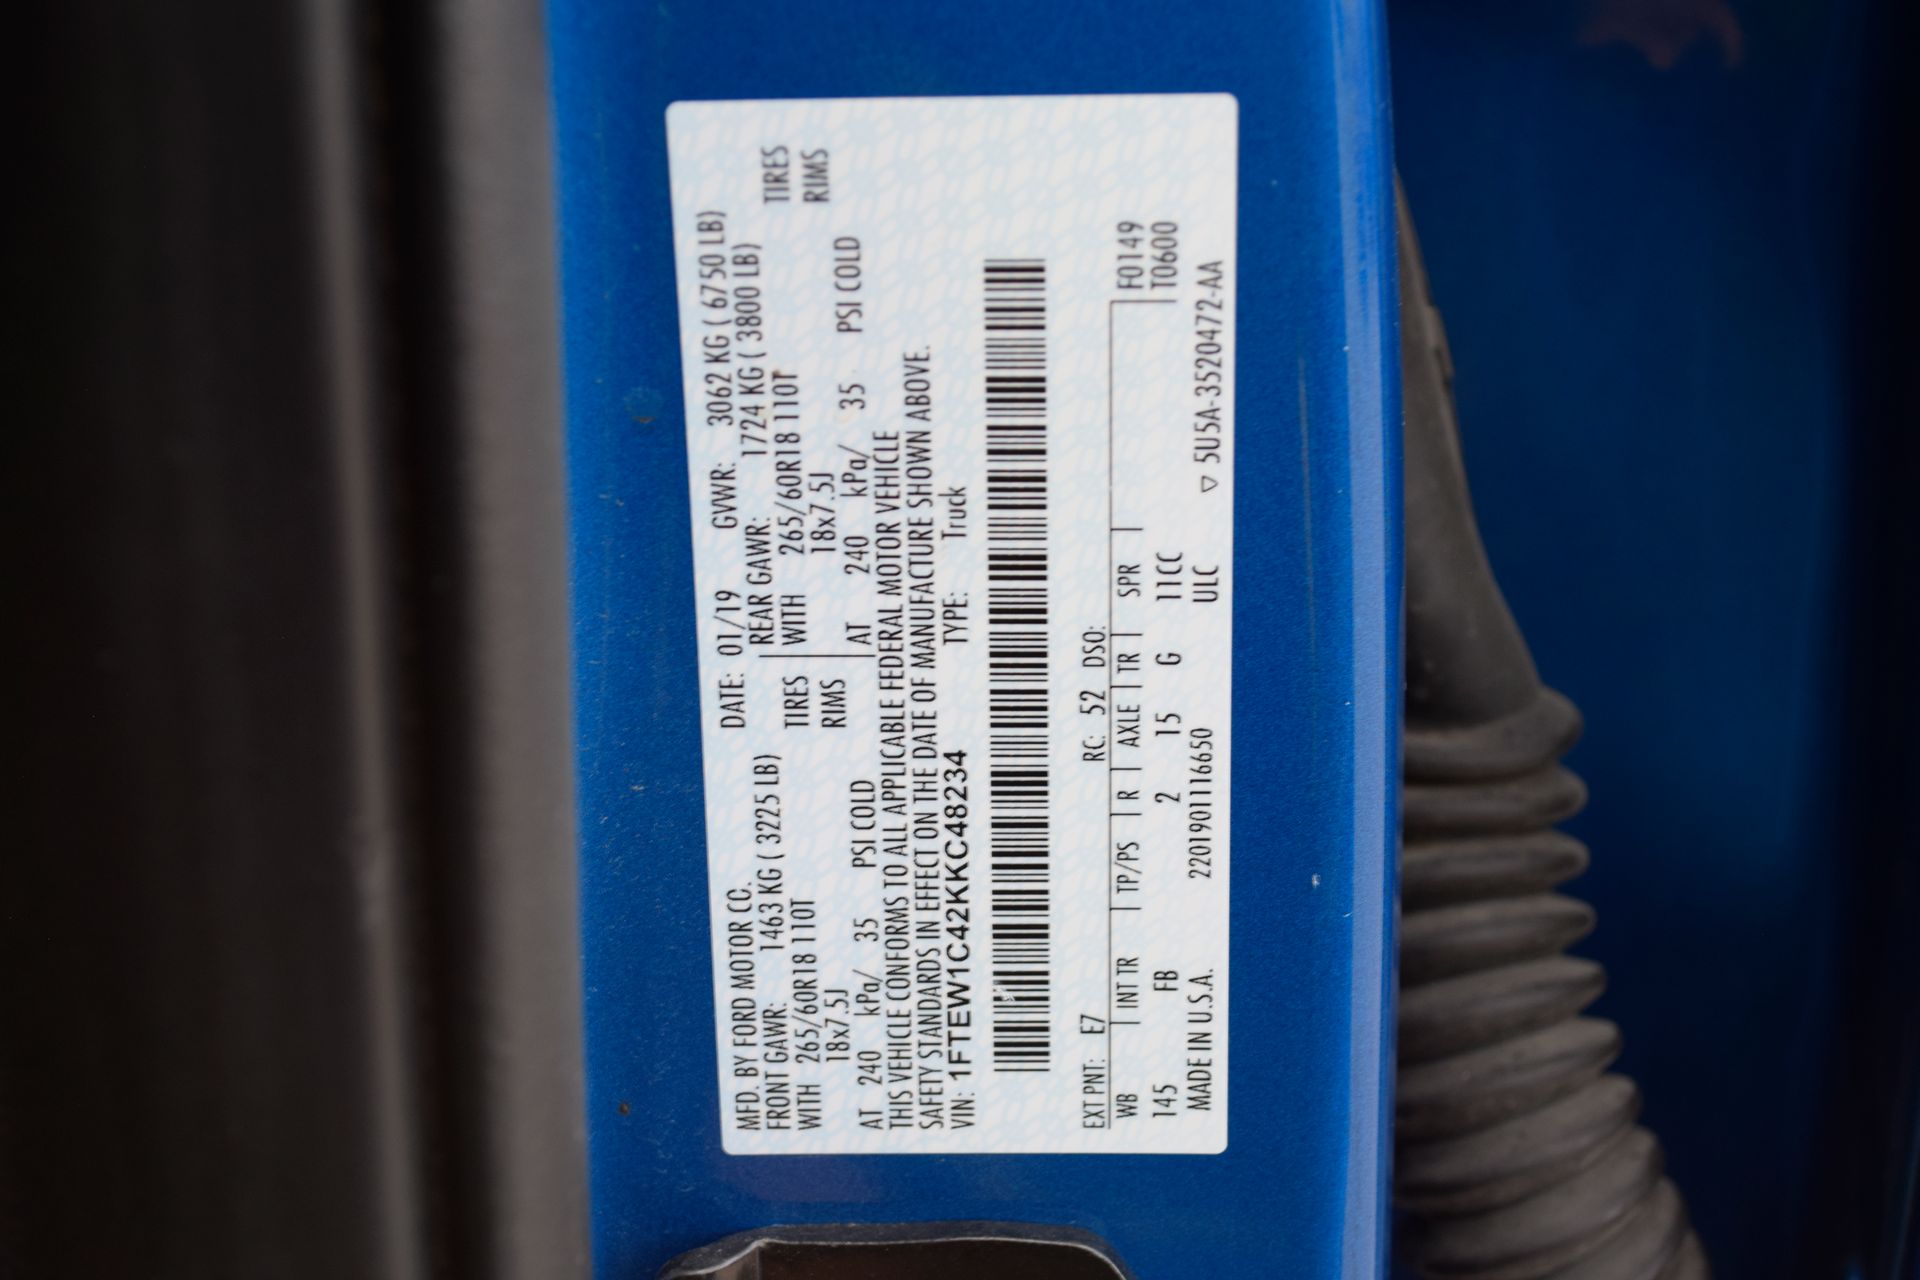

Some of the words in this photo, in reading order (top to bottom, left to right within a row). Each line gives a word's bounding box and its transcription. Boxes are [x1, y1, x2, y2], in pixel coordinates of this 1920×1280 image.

[762, 146, 789, 202] TIRES
[801, 149, 828, 202] RIMS
[697, 211, 726, 244] LB)
[732, 244, 761, 277] LB)
[834, 237, 862, 292] COLD
[1117, 221, 1144, 289] F0149
[1151, 222, 1178, 289] T0600
[699, 254, 728, 309] 6750
[734, 287, 762, 341] 3800
[835, 302, 863, 333] PSI
[703, 335, 730, 363] KG
[1194, 261, 1222, 463] 5U5A-3520472-AA
[704, 373, 733, 426] 3062
[737, 367, 765, 395] KG
[772, 370, 799, 421] 110T
[838, 384, 865, 410] 35
[903, 345, 931, 422] ABOVE.
[739, 405, 767, 457] 1724
[774, 432, 807, 555] 265/60R18
[838, 444, 871, 497] kPa/
[872, 432, 901, 514] VEHICLE
[905, 431, 933, 509] SHOWN
[710, 463, 738, 529] GVWR:
[808, 473, 836, 554] 18x7.5J
[937, 487, 967, 540] Truck
[744, 518, 773, 585] GAWR:
[843, 536, 870, 575] 240
[875, 522, 902, 596] MOTOR
[907, 518, 936, 669] MANUFACTURE
[1117, 564, 1141, 597] SPR
[1155, 552, 1183, 601] 11CC
[1192, 566, 1219, 603] ULC
[713, 590, 746, 656] 01/19
[747, 594, 775, 645] REAR
[780, 595, 807, 646] WITH
[845, 622, 872, 645] AT
[942, 592, 969, 646] TYPE:
[877, 604, 905, 690] FEDERAL
[1082, 626, 1106, 667] DSO:
[1117, 653, 1140, 674] TR
[1155, 652, 1182, 666] G
[718, 673, 746, 728] DATE:
[782, 675, 810, 729] TIRES
[819, 679, 847, 728] RIMS
[910, 678, 937, 703] OF
[1079, 690, 1106, 715] 52
[911, 711, 938, 759] DATE
[1082, 736, 1106, 761] RC:
[1117, 704, 1140, 748] AXLE
[1155, 713, 1181, 737] 15
[753, 754, 782, 785] LB)
[879, 699, 907, 816] APPLICABLE
[850, 780, 876, 830] COLD
[912, 768, 938, 804] THE
[1116, 790, 1140, 800] R
[1154, 792, 1181, 803] 2
[1188, 728, 1213, 879] 2201901116650
[754, 794, 781, 844] 3225
[882, 823, 908, 857] ALL
[913, 812, 939, 839] ON
[850, 840, 877, 868] PSI
[882, 864, 909, 889] TO
[1114, 842, 1142, 894] TP/PS
[726, 882, 752, 913] CO.
[756, 868, 783, 894] KG
[913, 848, 940, 911] EFFECT
[758, 903, 785, 951] 1463
[790, 898, 816, 944] 110T
[853, 918, 879, 942] 35
[915, 921, 941, 939] IN
[942, 749, 972, 1081] 1FTEW1C42KKC48234
[728, 921, 755, 990] MOTOR
[883, 896, 911, 1001] CONFORMS
[1116, 957, 1139, 976] TR
[852, 969, 883, 1016] kPa/
[915, 948, 943, 1059] STANDARDS
[1116, 982, 1139, 1008] INT
[1153, 970, 1179, 991] FB
[1187, 969, 1213, 1023] U.S.A.
[731, 997, 758, 1047] FORD
[791, 953, 823, 1064] 265/60R18
[824, 989, 850, 1062] 18x7.5J
[1080, 1014, 1106, 1034] E7
[762, 1003, 789, 1063] GAWR:
[886, 1010, 913, 1083] VEHICLE
[1187, 1032, 1212, 1051] IN
[733, 1055, 759, 1077] BY
[857, 1051, 883, 1086] 240
[1082, 1059, 1105, 1094] PNT:
[1186, 1058, 1212, 1111] MADE
[735, 1086, 761, 1131] MFD.
[764, 1071, 791, 1130] FRONT
[796, 1084, 822, 1130] WITH
[858, 1109, 883, 1130] AT
[887, 1090, 914, 1130] THIS
[918, 1066, 944, 1130] SAFETY
[950, 1093, 975, 1129] VIN:
[1082, 1100, 1105, 1128] EXT
[1116, 1094, 1138, 1119] WB
[1152, 1084, 1178, 1118] 145
